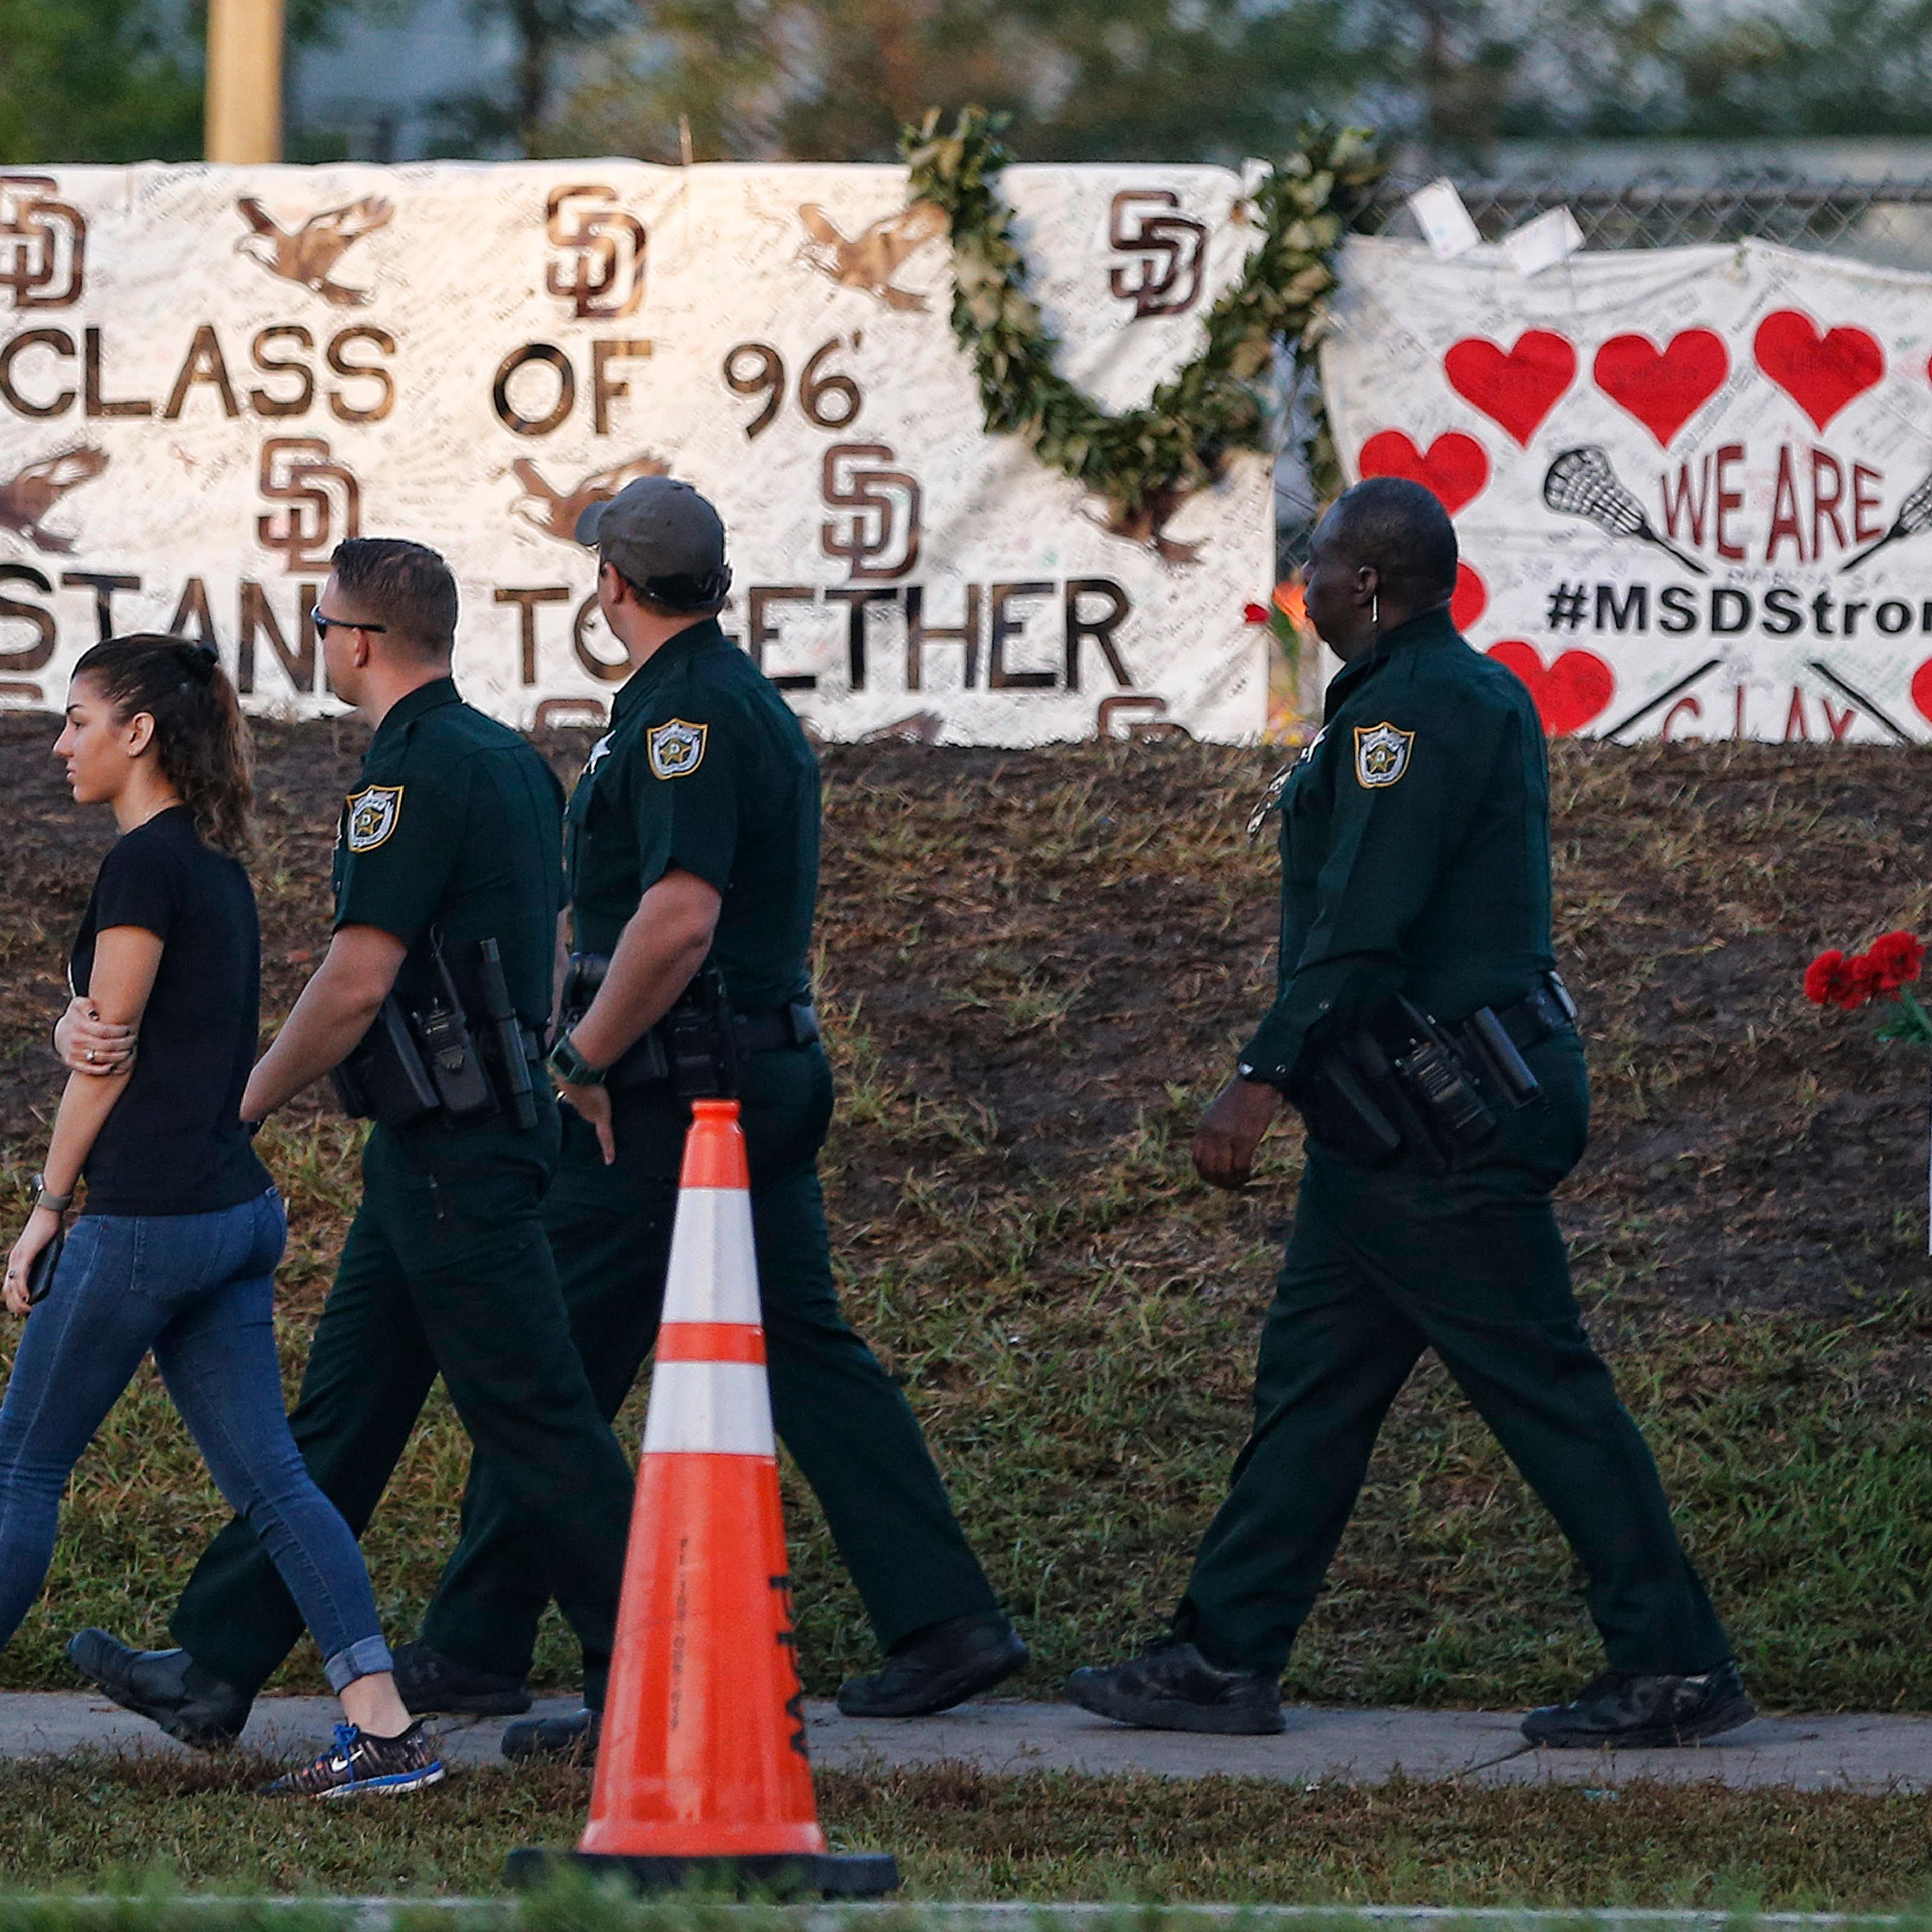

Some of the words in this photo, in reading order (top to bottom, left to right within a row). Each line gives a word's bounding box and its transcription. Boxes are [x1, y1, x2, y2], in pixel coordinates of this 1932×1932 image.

[0, 325, 396, 423] CLASS
[493, 340, 652, 436] OF
[1661, 444, 1746, 561] WE
[1765, 444, 1884, 563] ARE
[0, 563, 332, 693] STAN
[494, 579, 1133, 691] TOETHER
[1547, 582, 1932, 635] #MSDStro
